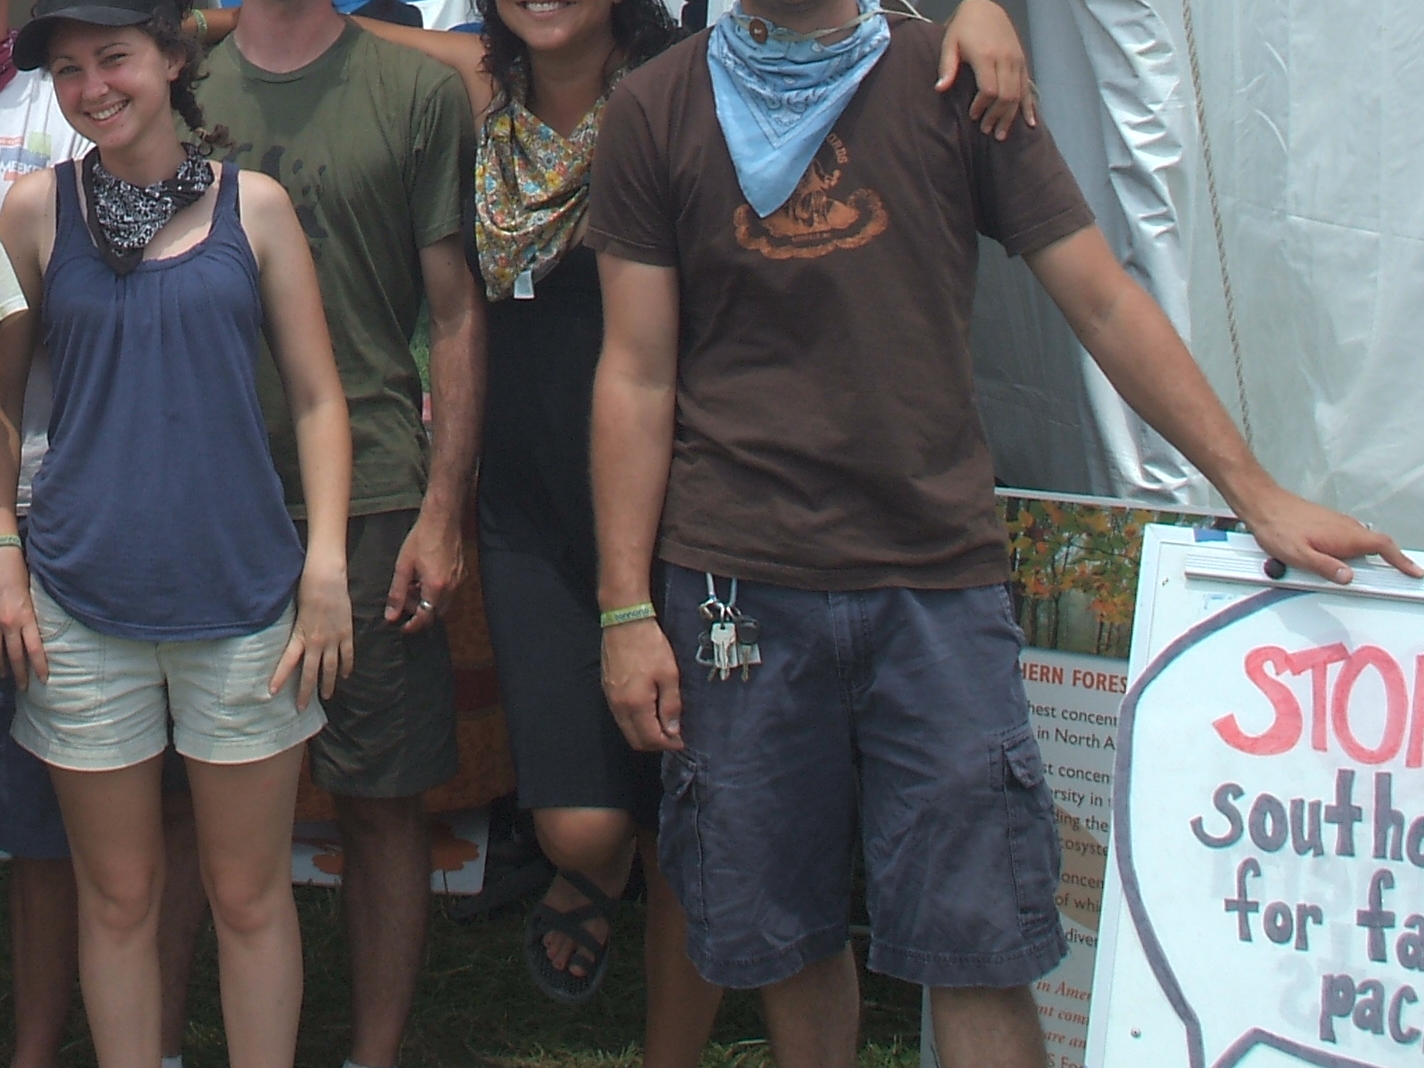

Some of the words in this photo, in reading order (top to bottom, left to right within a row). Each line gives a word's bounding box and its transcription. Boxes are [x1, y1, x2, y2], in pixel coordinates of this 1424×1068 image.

[1037, 725, 1049, 740] in
[1055, 728, 1100, 749] North
[1091, 792, 1103, 807] in
[1086, 815, 1108, 833] the
[1224, 857, 1324, 951] for
